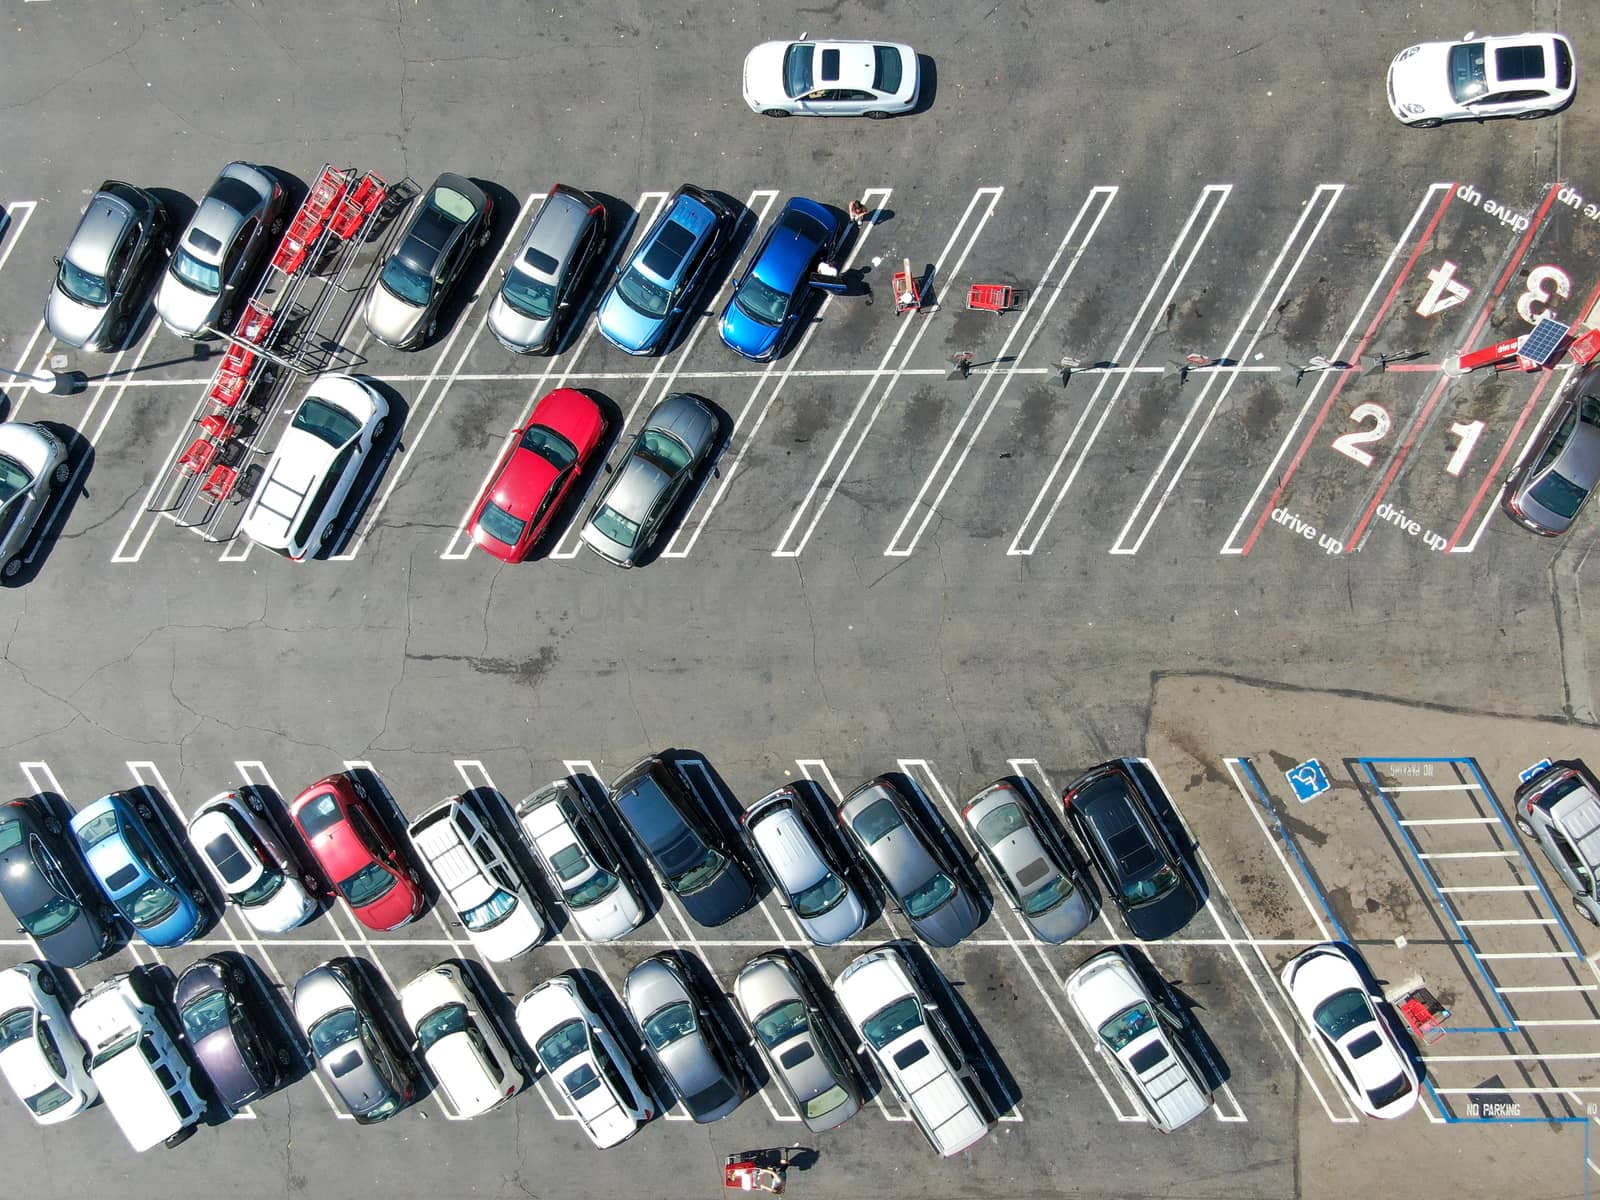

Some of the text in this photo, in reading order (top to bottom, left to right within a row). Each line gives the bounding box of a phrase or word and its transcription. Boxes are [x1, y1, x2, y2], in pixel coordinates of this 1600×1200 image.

[1456, 184, 1529, 232] drive up
[1557, 187, 1582, 210] up
[1415, 259, 1472, 318] 4
[1516, 265, 1571, 326] 3
[1331, 402, 1391, 468] 2
[1446, 420, 1487, 477] 1
[1271, 506, 1344, 555] drive up
[1376, 502, 1448, 552] drive up
[1466, 1103, 1521, 1116] NO PARKING
[1587, 1103, 1598, 1115] NO
